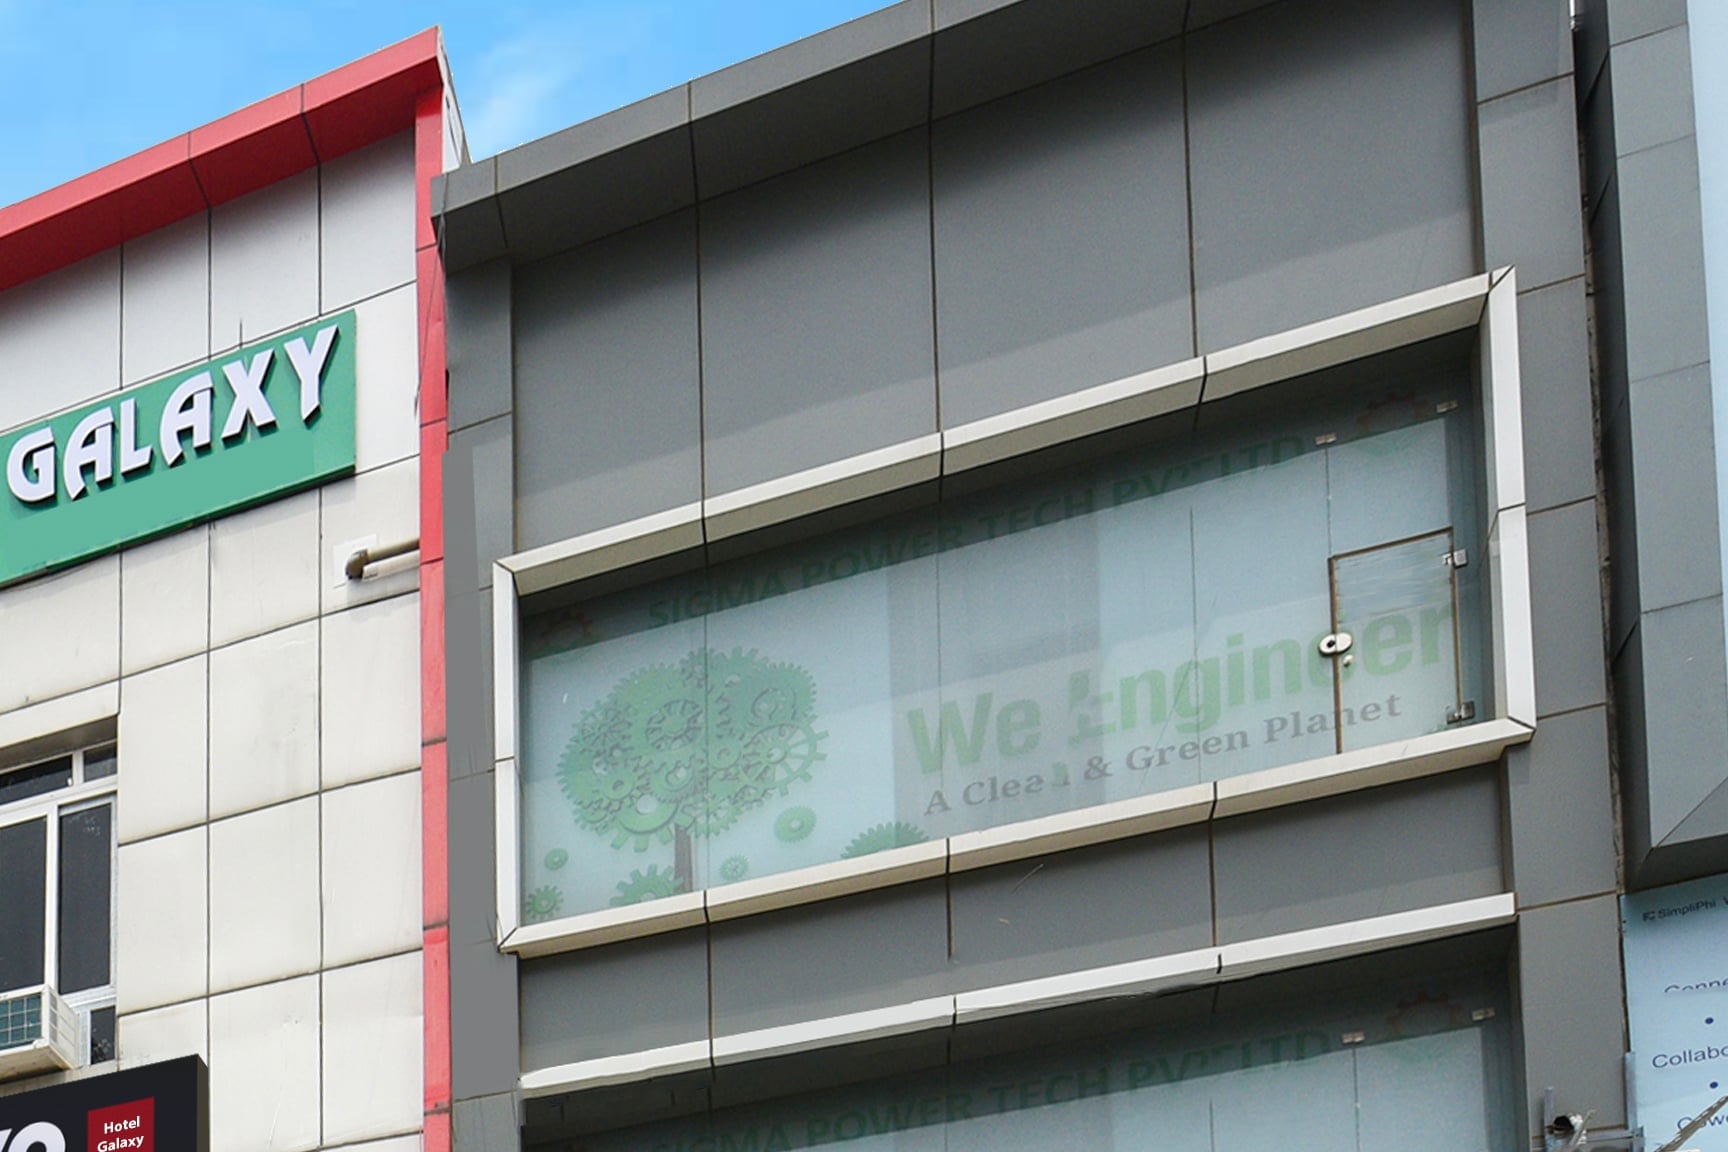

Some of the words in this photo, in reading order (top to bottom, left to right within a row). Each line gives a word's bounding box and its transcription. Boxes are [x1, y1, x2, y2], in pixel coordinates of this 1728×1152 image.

[6, 323, 340, 502] GALAXY
[649, 566, 790, 630] SIGMA
[800, 522, 966, 593] POWER
[978, 484, 1100, 549] TECH
[905, 690, 1044, 776] We
[924, 786, 951, 815] A
[1085, 753, 1115, 783] &
[1125, 726, 1250, 775] Green
[1262, 692, 1404, 749] Planet
[96, 1133, 145, 1152] Galaxy
[104, 1115, 141, 1135] Hotel
[805, 1086, 975, 1146] POWER
[986, 1062, 1110, 1114] TECH
